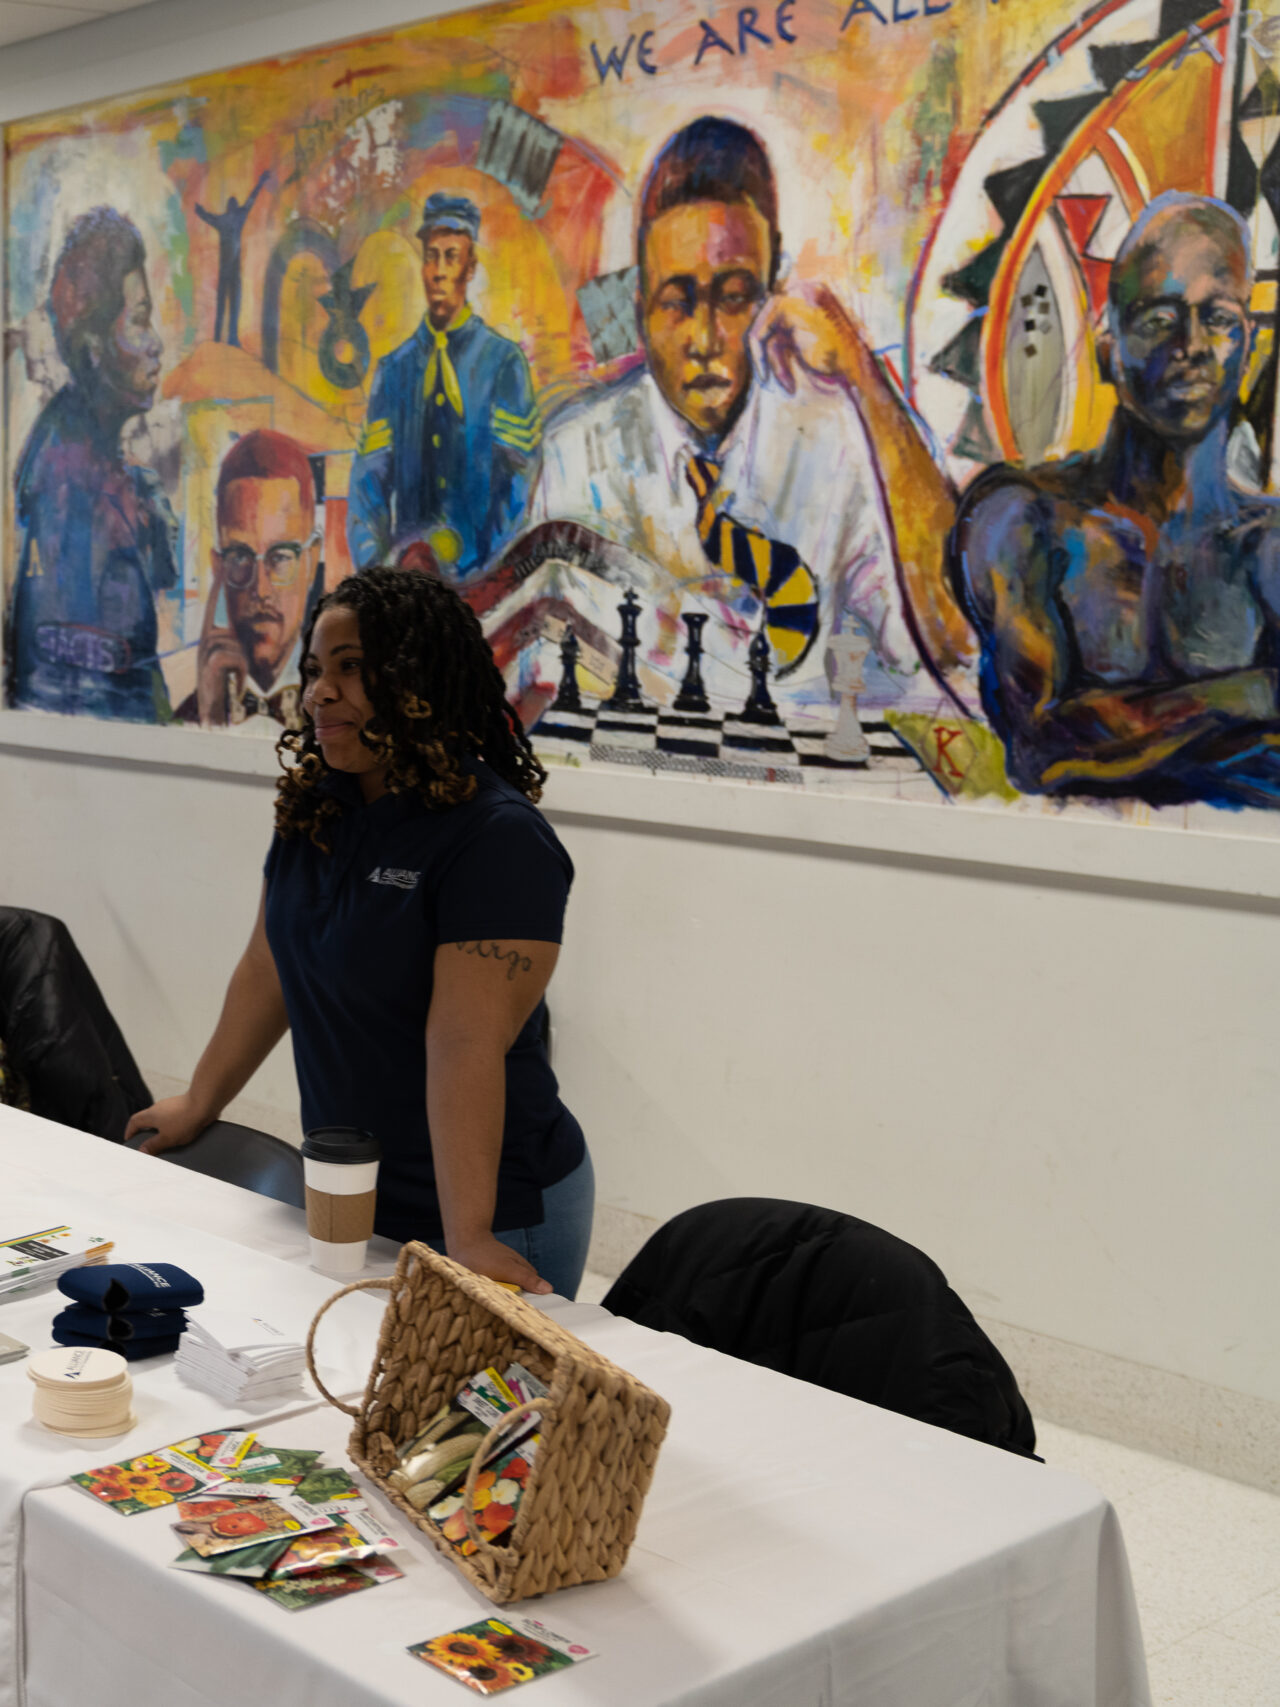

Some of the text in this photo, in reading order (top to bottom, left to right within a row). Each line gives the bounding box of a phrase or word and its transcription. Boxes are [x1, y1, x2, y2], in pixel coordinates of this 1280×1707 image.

[590, 29, 657, 84] WE
[694, 0, 797, 65] ARE
[932, 726, 965, 778] K
